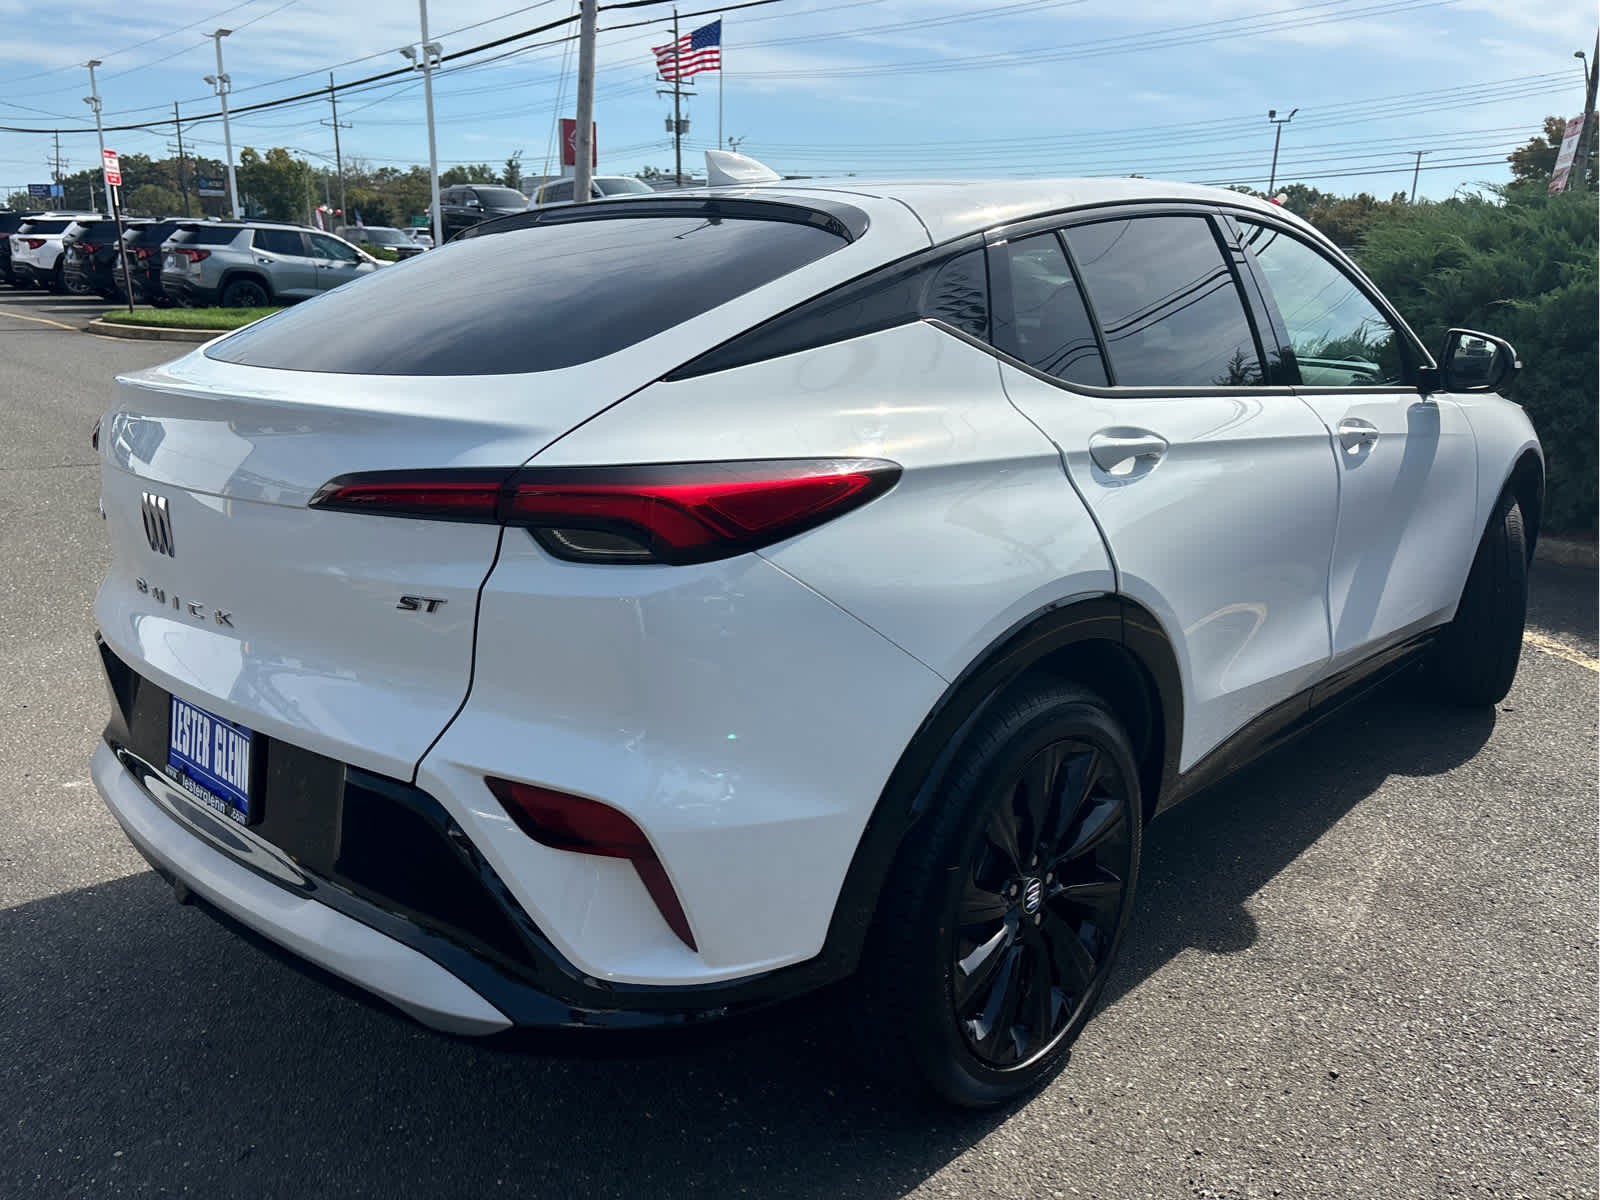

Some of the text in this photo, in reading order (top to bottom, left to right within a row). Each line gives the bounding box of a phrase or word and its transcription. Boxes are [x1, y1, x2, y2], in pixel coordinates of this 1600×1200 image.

[135, 576, 235, 628] BUICK
[396, 595, 448, 613] ST
[171, 700, 250, 795] LESTER GLENN
